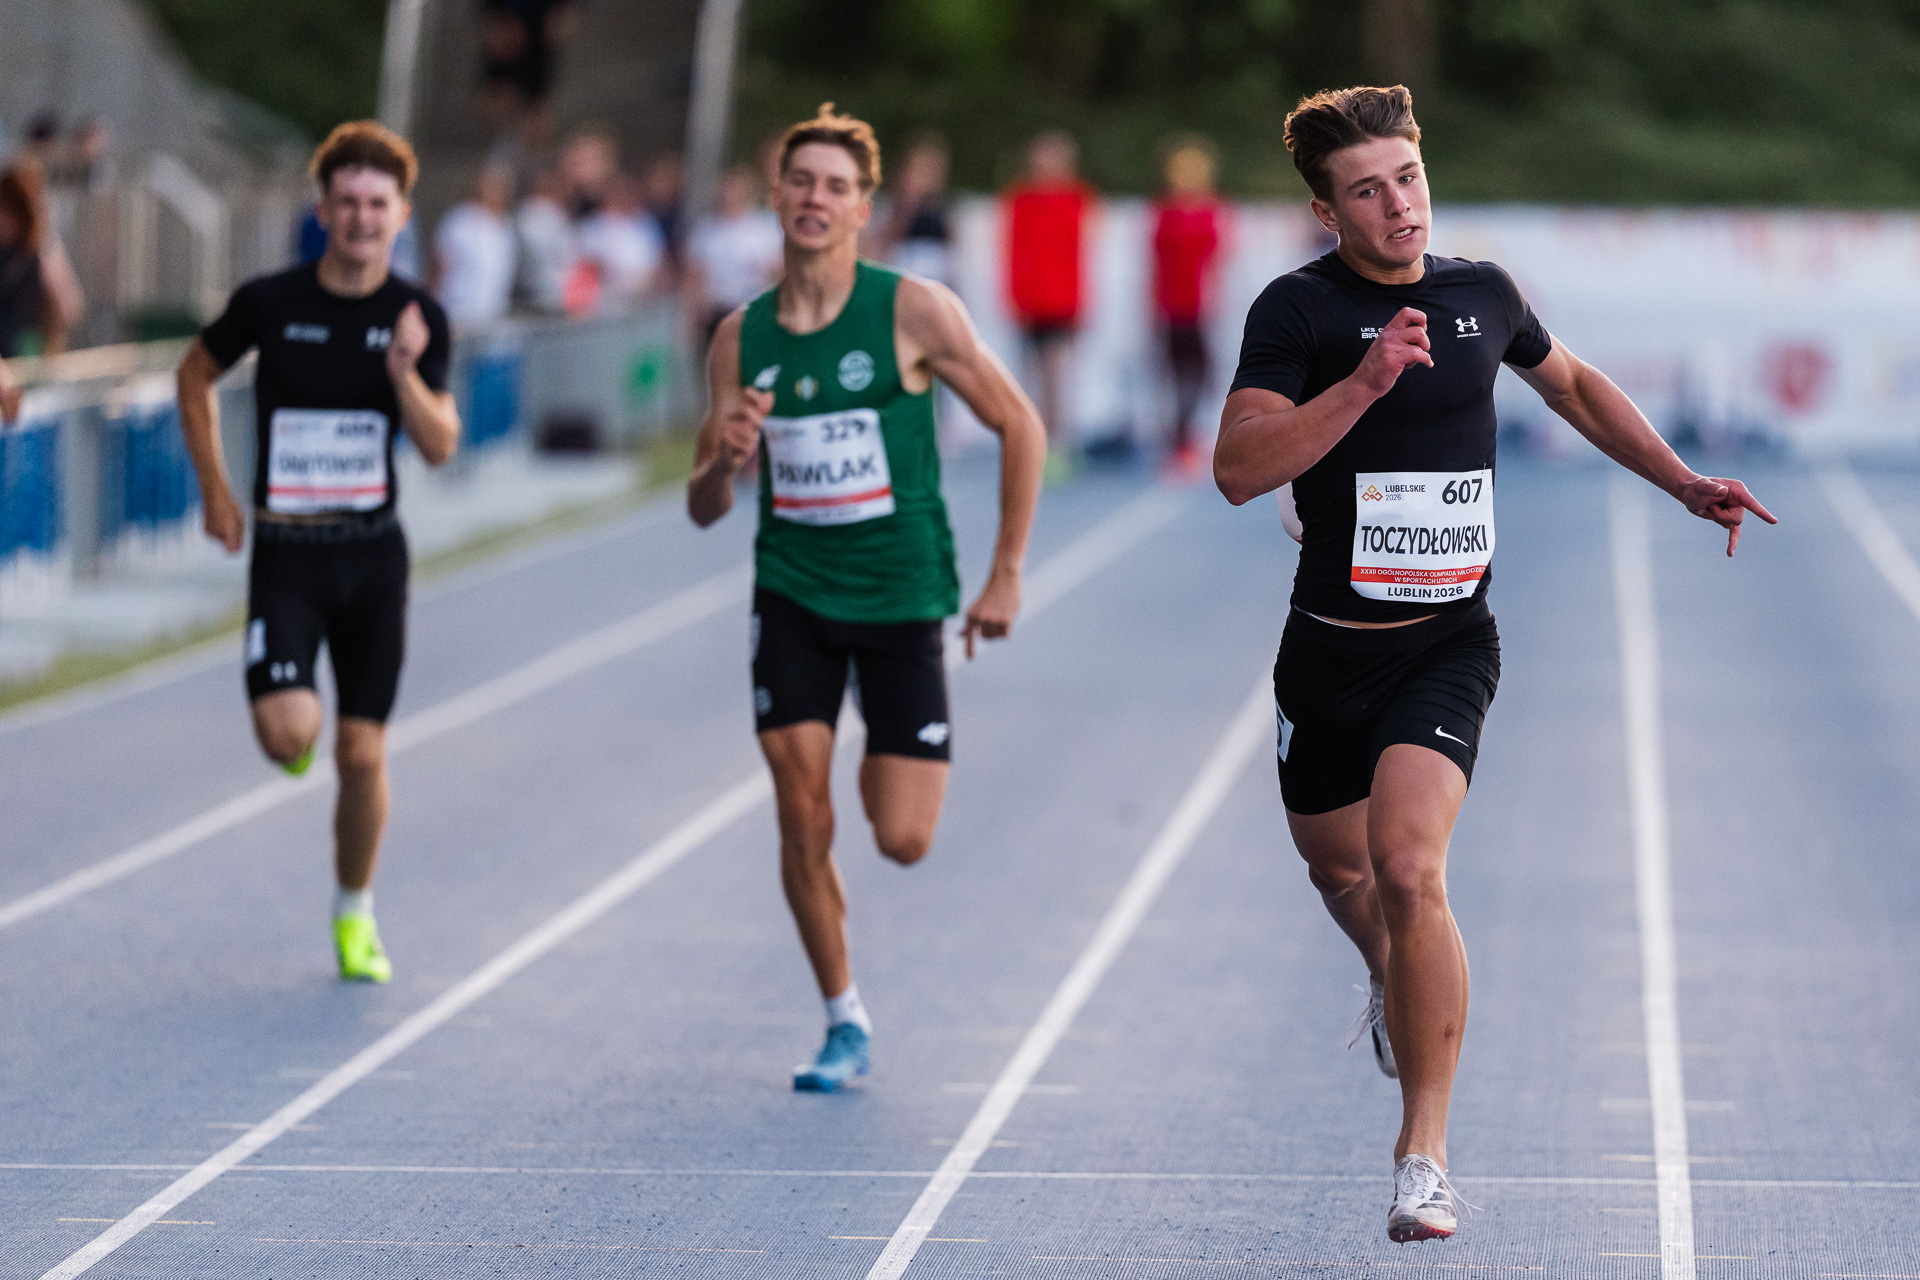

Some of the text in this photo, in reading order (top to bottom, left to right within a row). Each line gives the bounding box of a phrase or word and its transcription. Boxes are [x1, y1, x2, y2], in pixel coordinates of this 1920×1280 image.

[1385, 484, 1426, 493] LUBELSKIE
[1442, 477, 1483, 505] 607
[1361, 524, 1488, 555] TOCZYDŁOWSKI
[1377, 569, 1428, 577] OGÓLNOPOLSKA
[1402, 576, 1436, 584] SPORTACH
[1387, 585, 1464, 599] LUBLIN 2026
